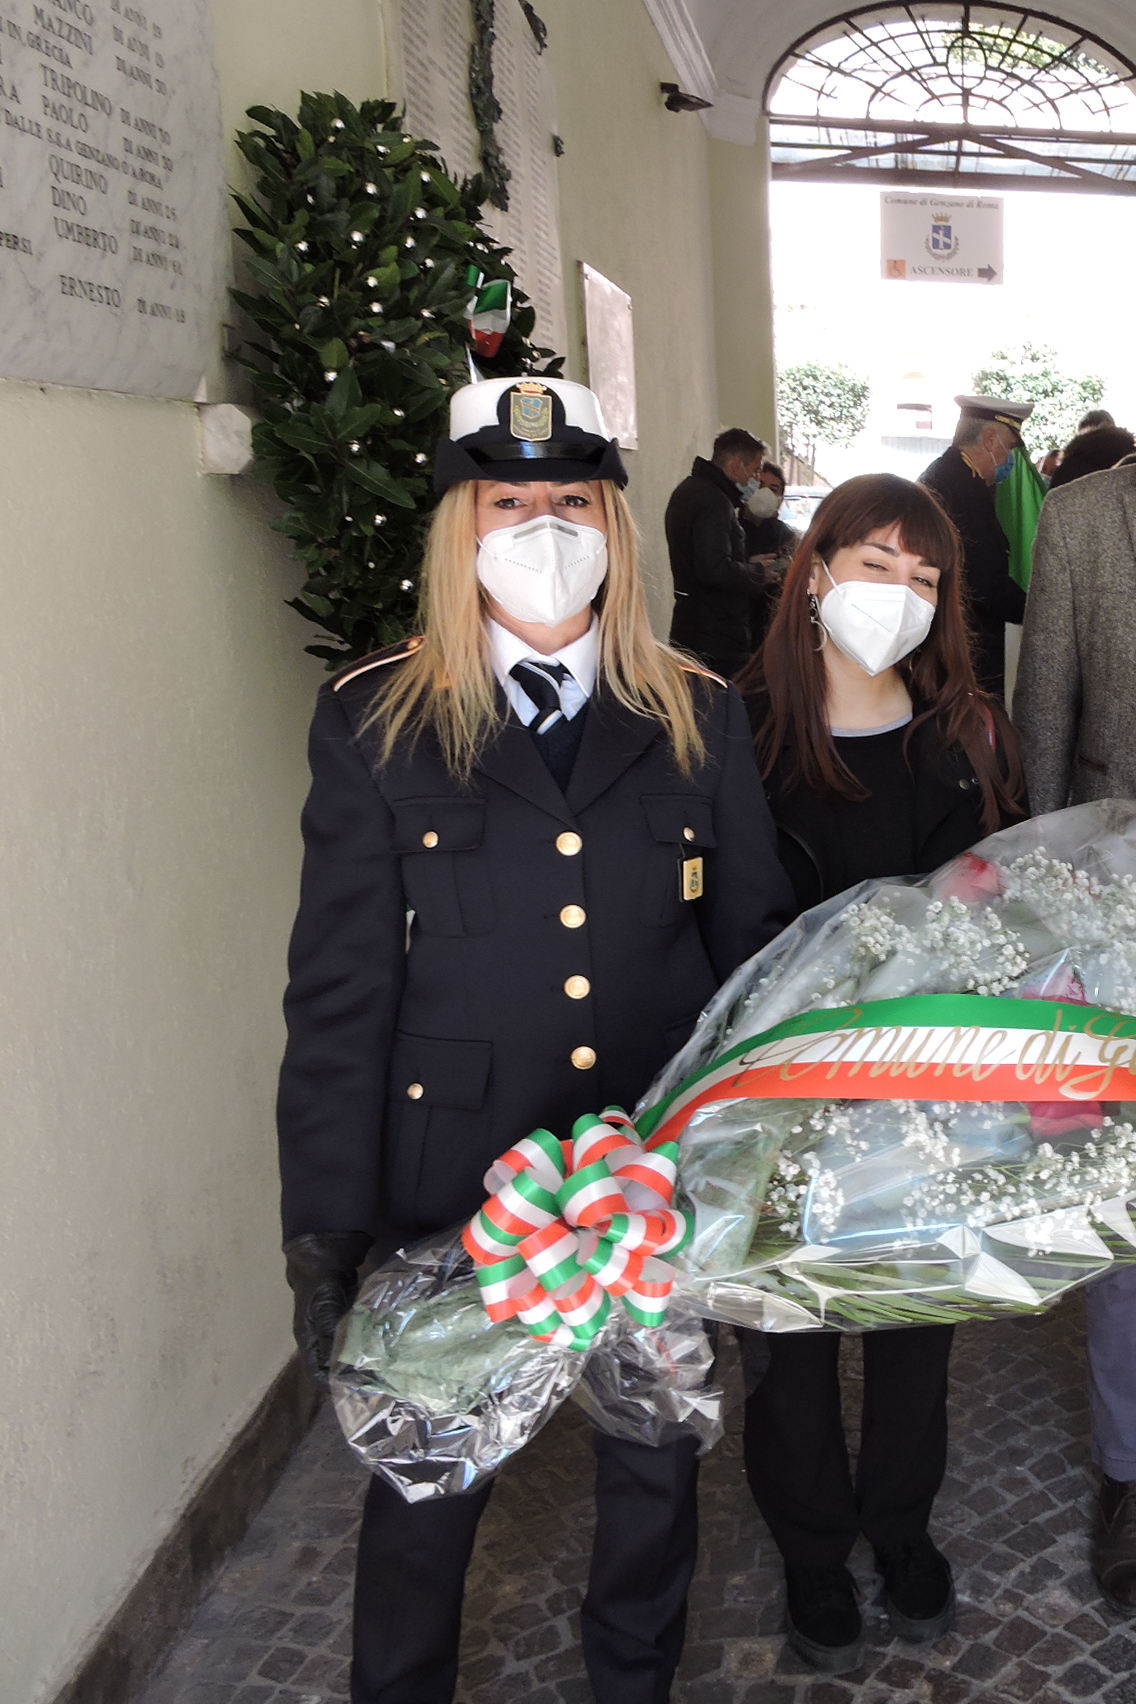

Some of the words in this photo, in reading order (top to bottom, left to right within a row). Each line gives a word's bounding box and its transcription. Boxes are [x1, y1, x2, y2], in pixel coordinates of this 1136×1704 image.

[32, 4, 94, 56] MAZZINI
[0, 75, 21, 105] RA
[42, 94, 88, 133] PAOLO
[40, 62, 112, 116] TRIPOLINO
[4, 108, 42, 140] DALLE
[50, 154, 108, 194] QUIRINO
[51, 185, 86, 216] DINO
[884, 196, 918, 206] Comune
[920, 197, 928, 206] di
[930, 198, 964, 208] Genzano
[966, 200, 974, 208] di
[976, 200, 999, 210] Roma
[0, 231, 33, 256] ERSI
[53, 216, 118, 254] UMBERTO
[910, 266, 974, 278] ASCENSORE
[59, 274, 121, 308] ERNESTO
[732, 1008, 1017, 1087] Comune
[1016, 1009, 1082, 1085] di
